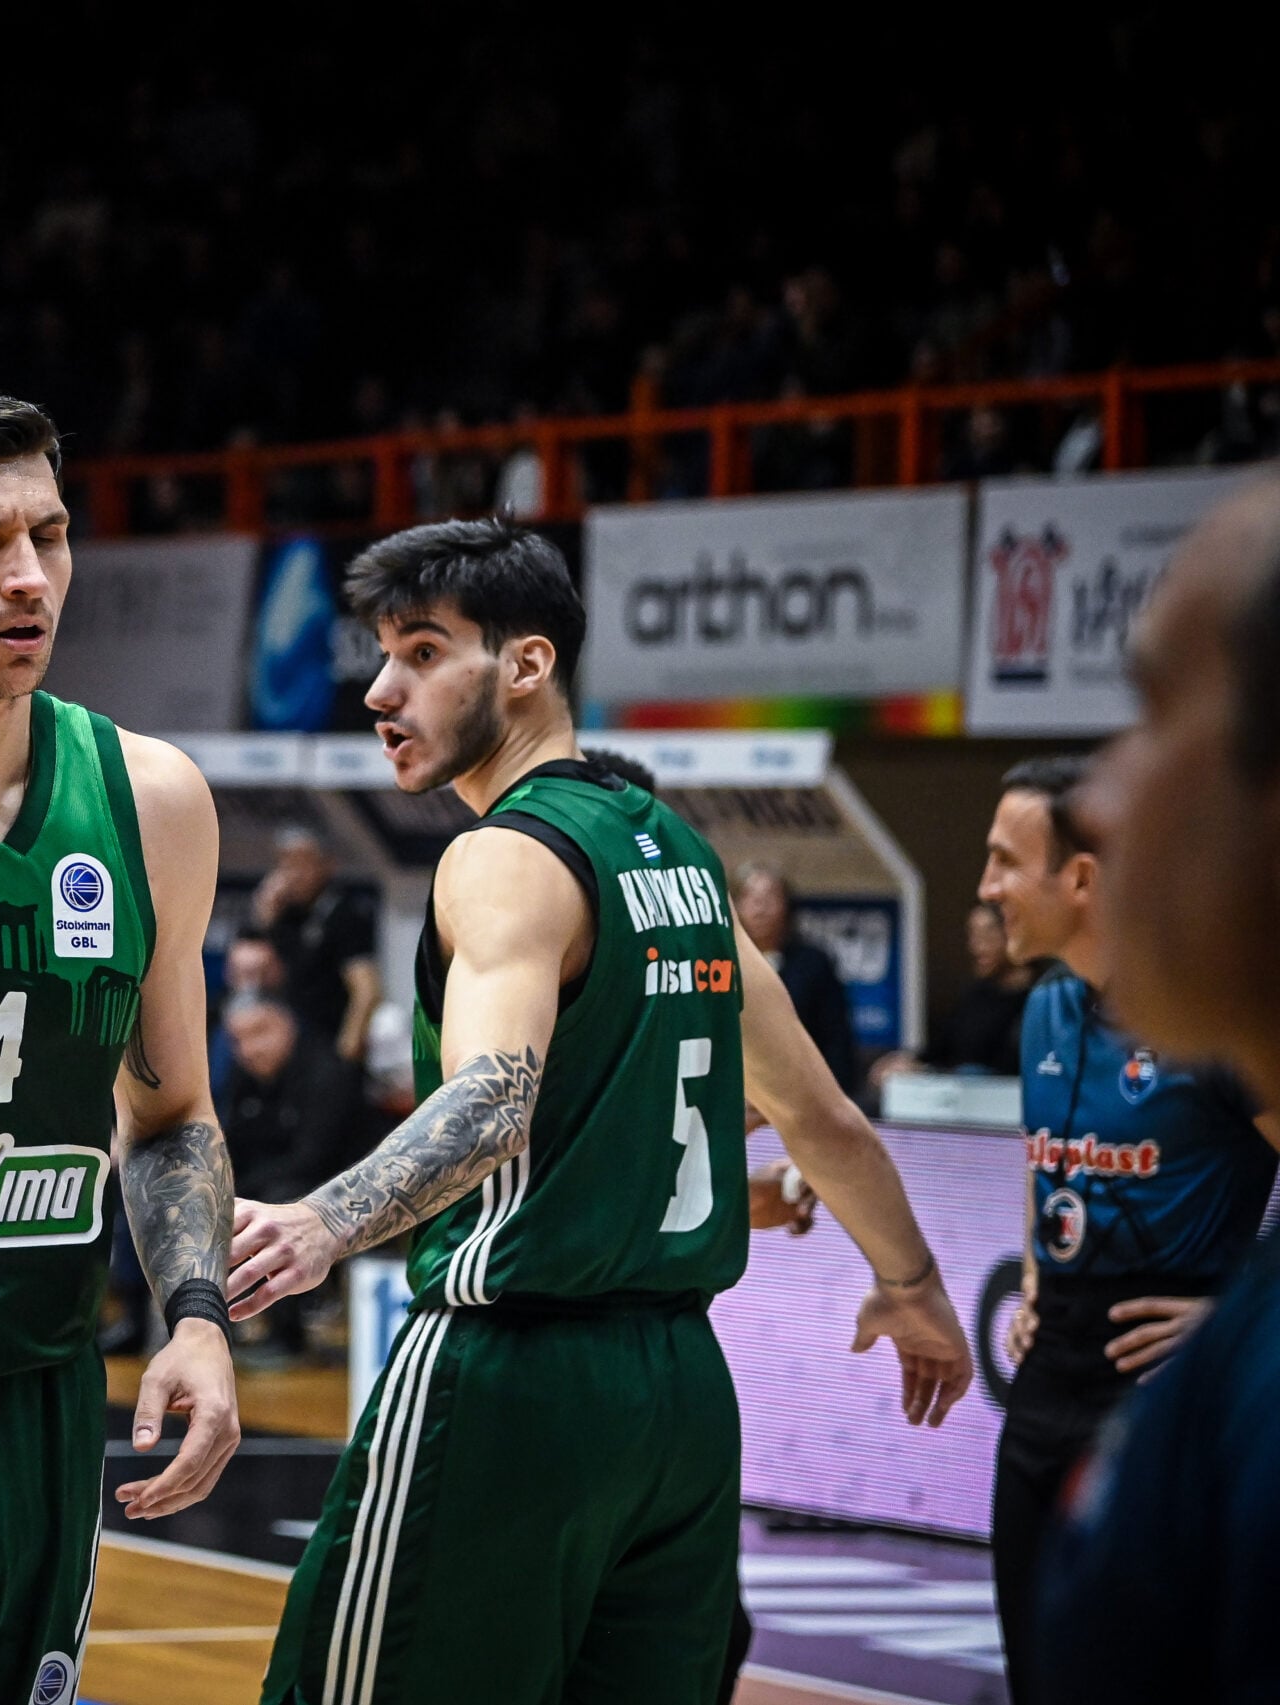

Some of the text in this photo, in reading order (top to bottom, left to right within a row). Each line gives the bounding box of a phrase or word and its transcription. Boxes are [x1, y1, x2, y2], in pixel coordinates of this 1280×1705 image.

[625, 550, 876, 647] arthon
[56, 919, 111, 931] Stoiximan
[71, 936, 98, 949] GBL
[659, 1037, 714, 1232] 5
